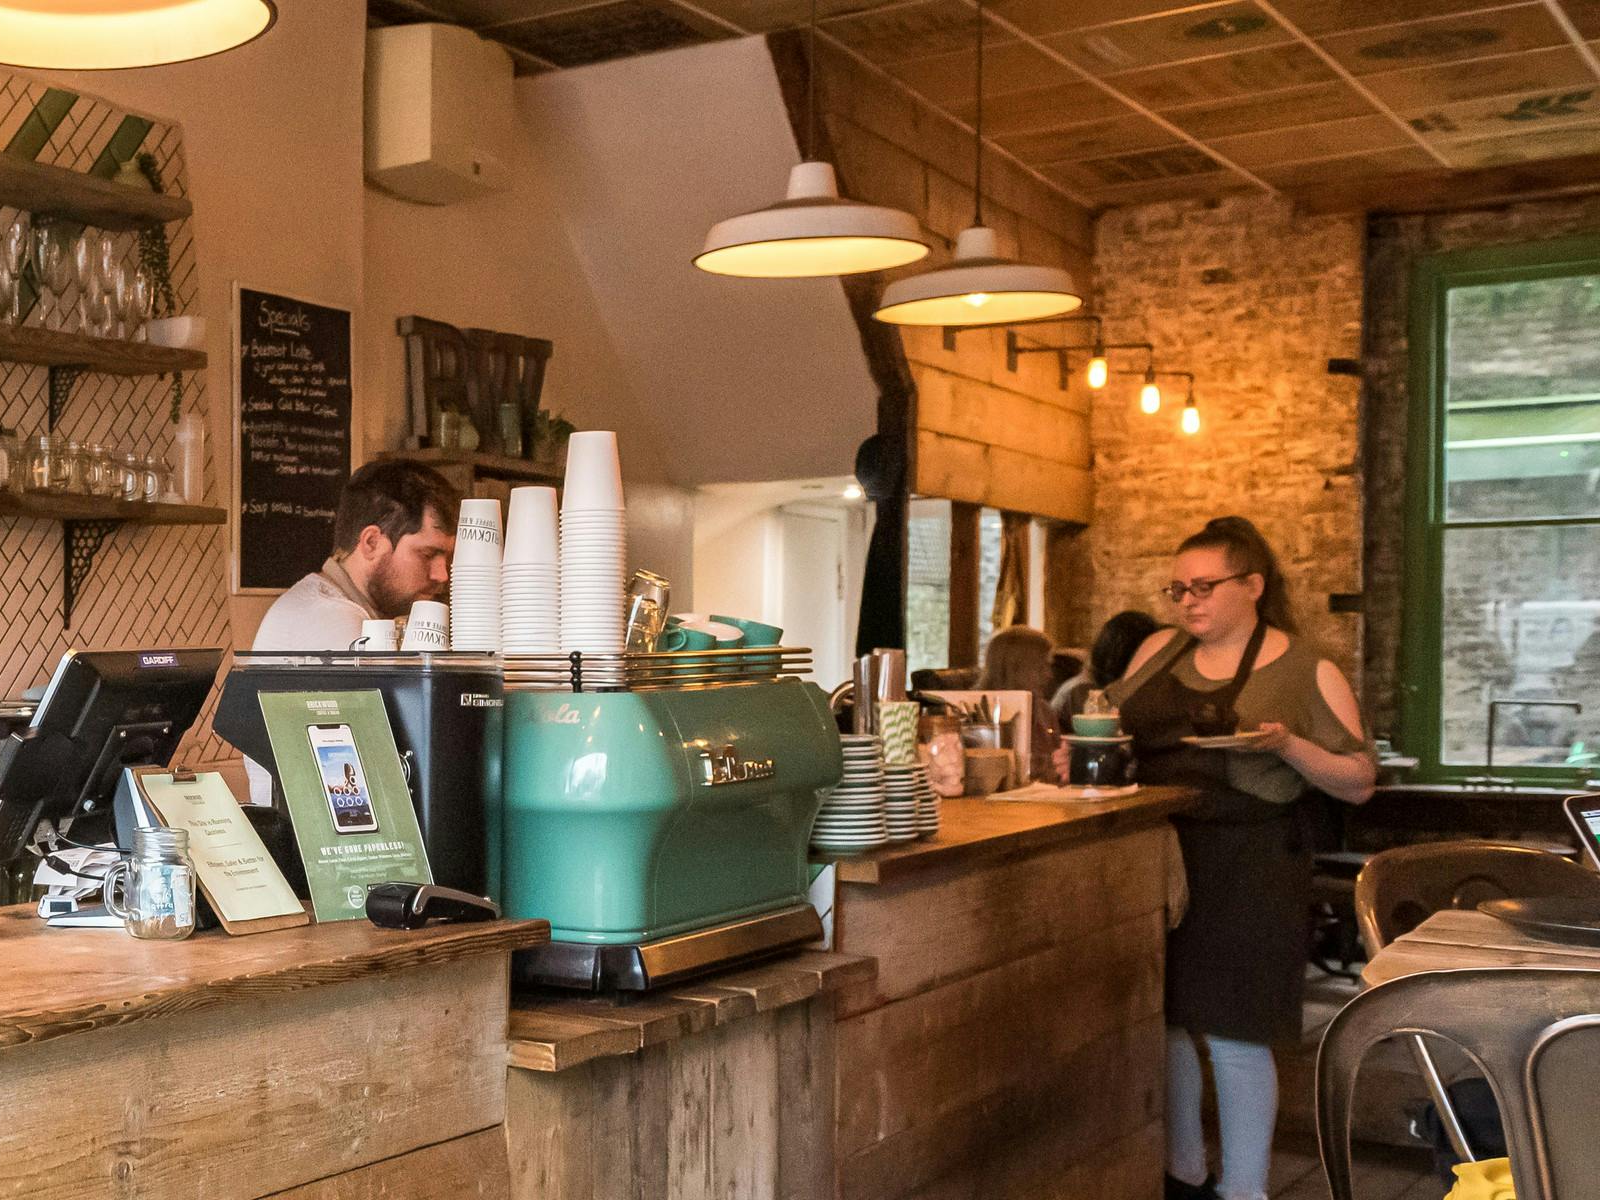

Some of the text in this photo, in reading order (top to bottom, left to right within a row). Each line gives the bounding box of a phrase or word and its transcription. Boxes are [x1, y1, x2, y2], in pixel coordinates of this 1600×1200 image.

[258, 300, 311, 336] Specials
[320, 841, 405, 856] WE'VE GONE PAPERLESS!
